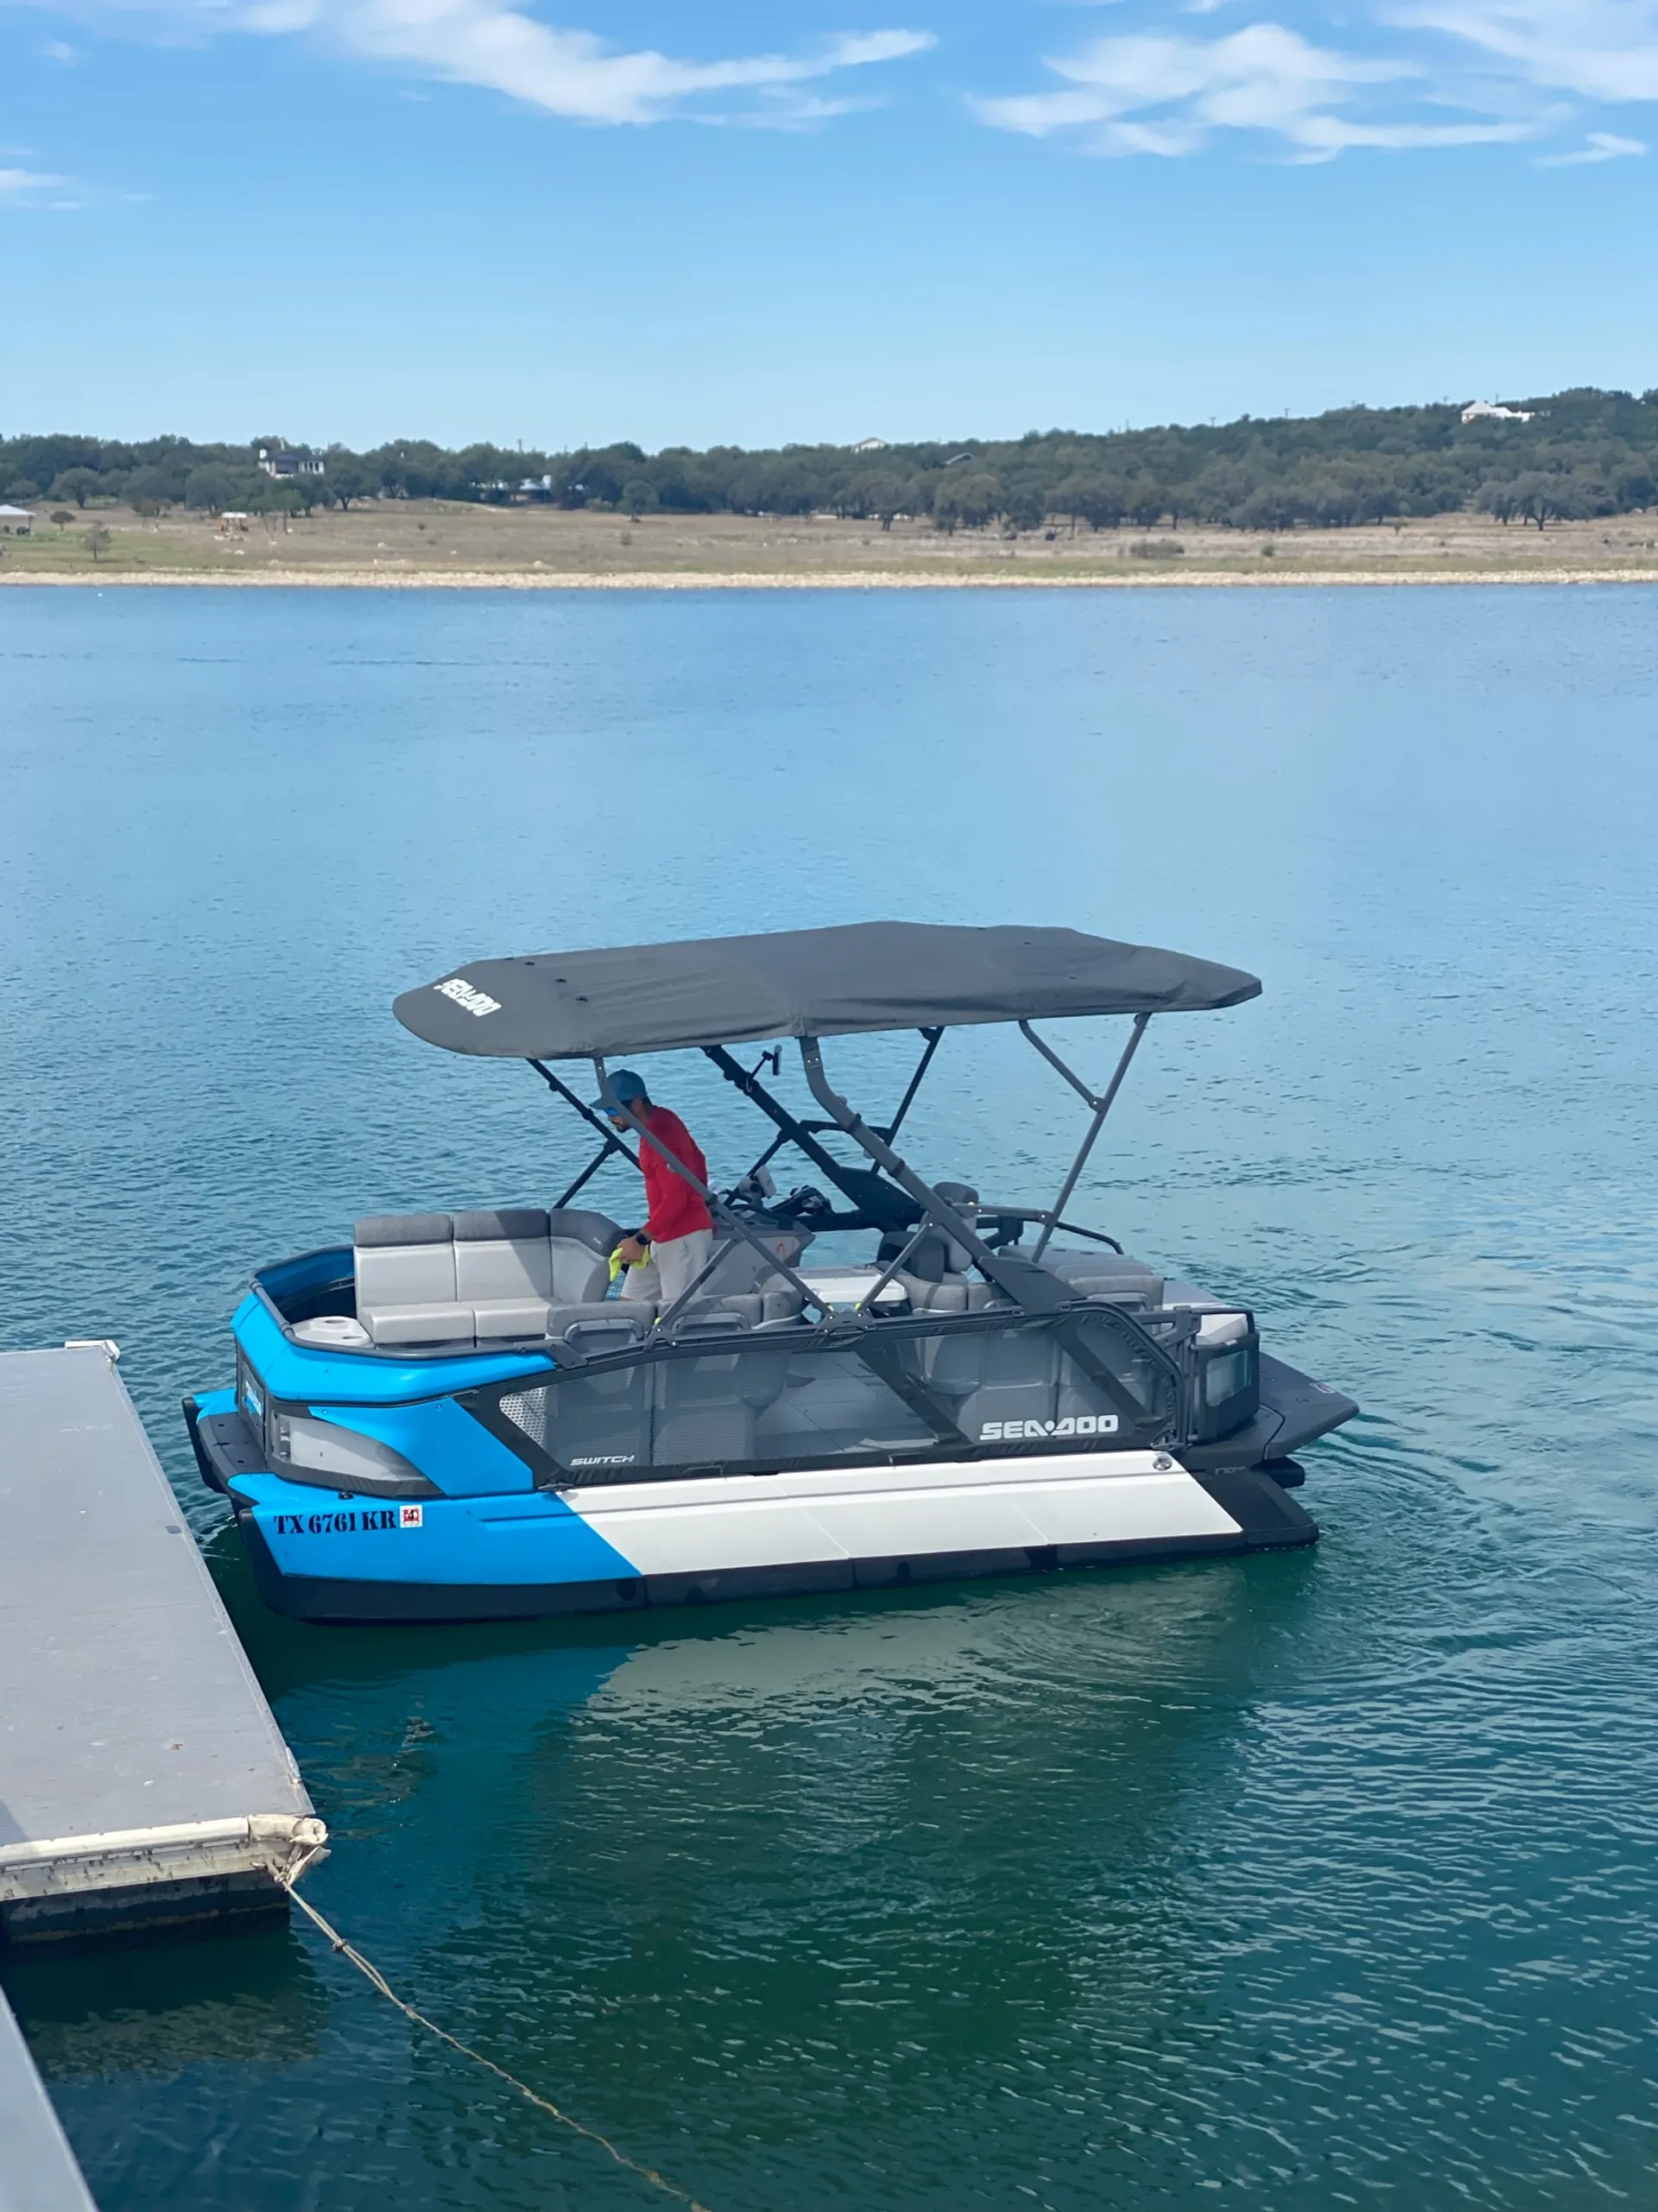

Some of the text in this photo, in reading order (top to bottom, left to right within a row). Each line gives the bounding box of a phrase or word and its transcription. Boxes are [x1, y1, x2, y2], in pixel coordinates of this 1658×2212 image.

[570, 1455, 636, 1466] SWITCH
[274, 1509, 397, 1535] TX 6761 KR
